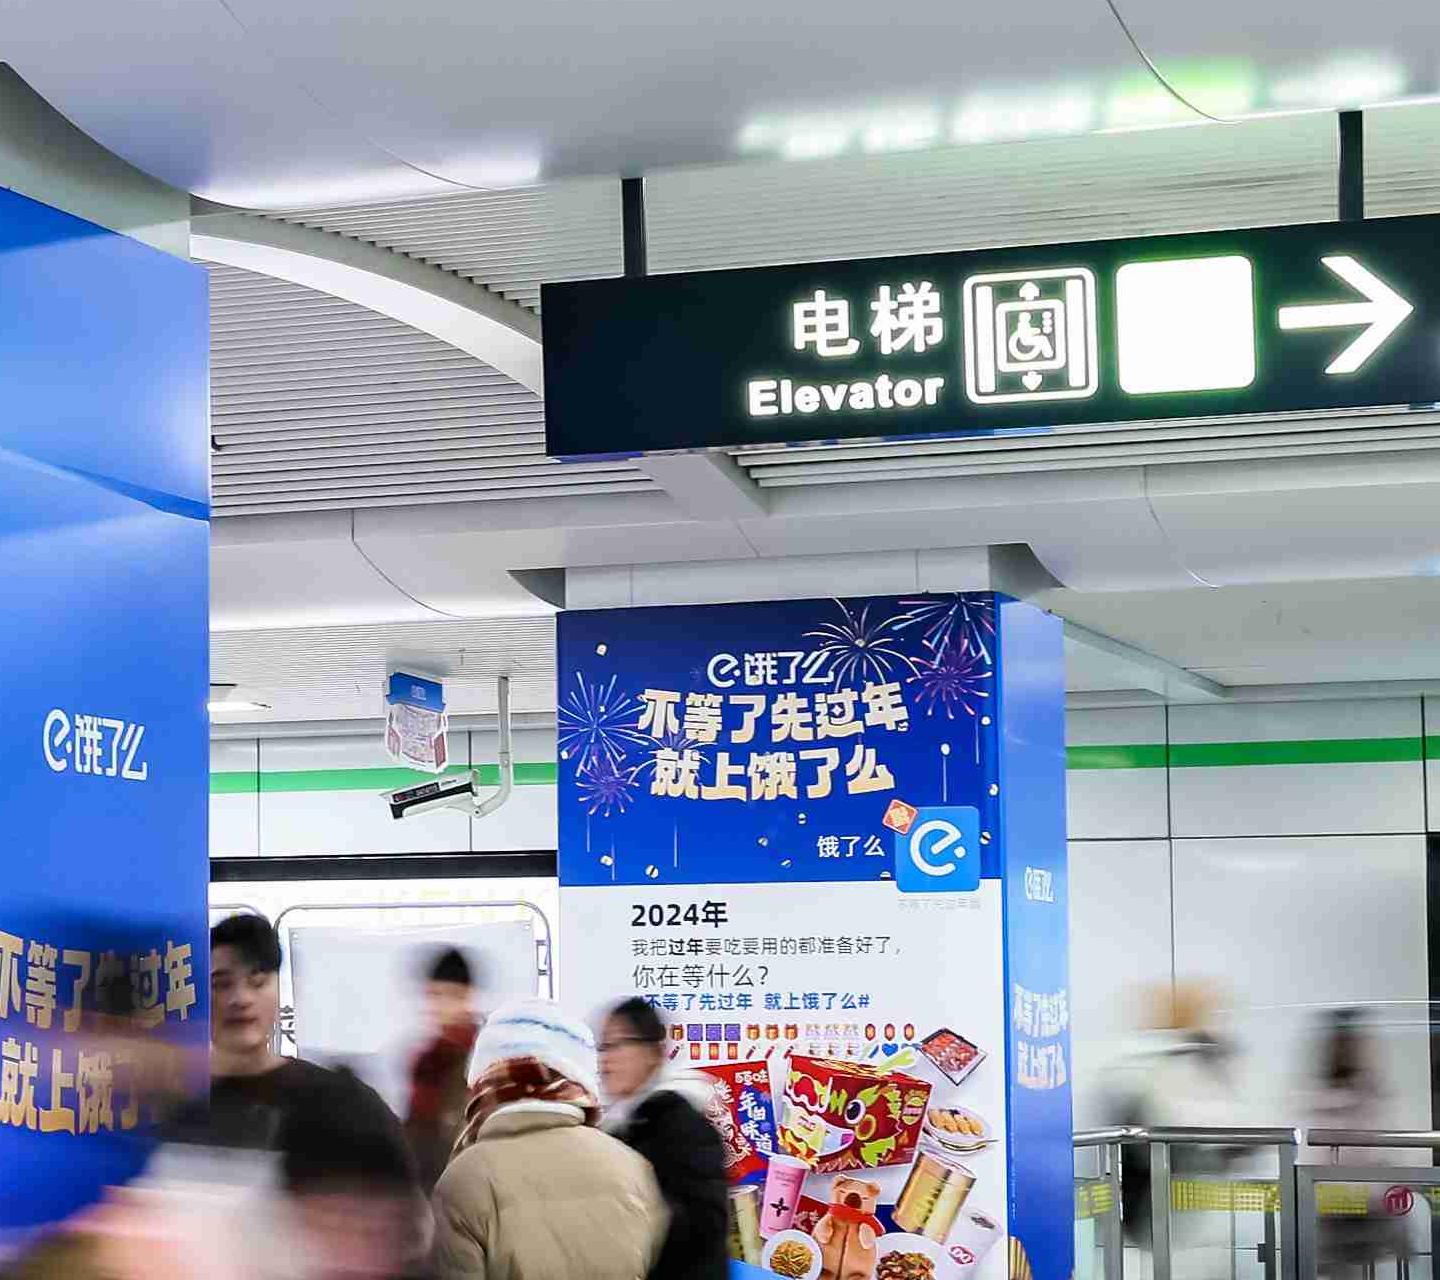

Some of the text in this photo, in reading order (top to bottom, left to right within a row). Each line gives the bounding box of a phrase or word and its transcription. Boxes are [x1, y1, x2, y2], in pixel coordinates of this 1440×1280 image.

[791, 282, 944, 357] 电梯
[747, 371, 945, 418] Elevator
[638, 684, 908, 745] 不等了先过年
[649, 746, 896, 802] 就上饿了么
[817, 835, 885, 859] 饿了么
[631, 900, 729, 928] 2024年
